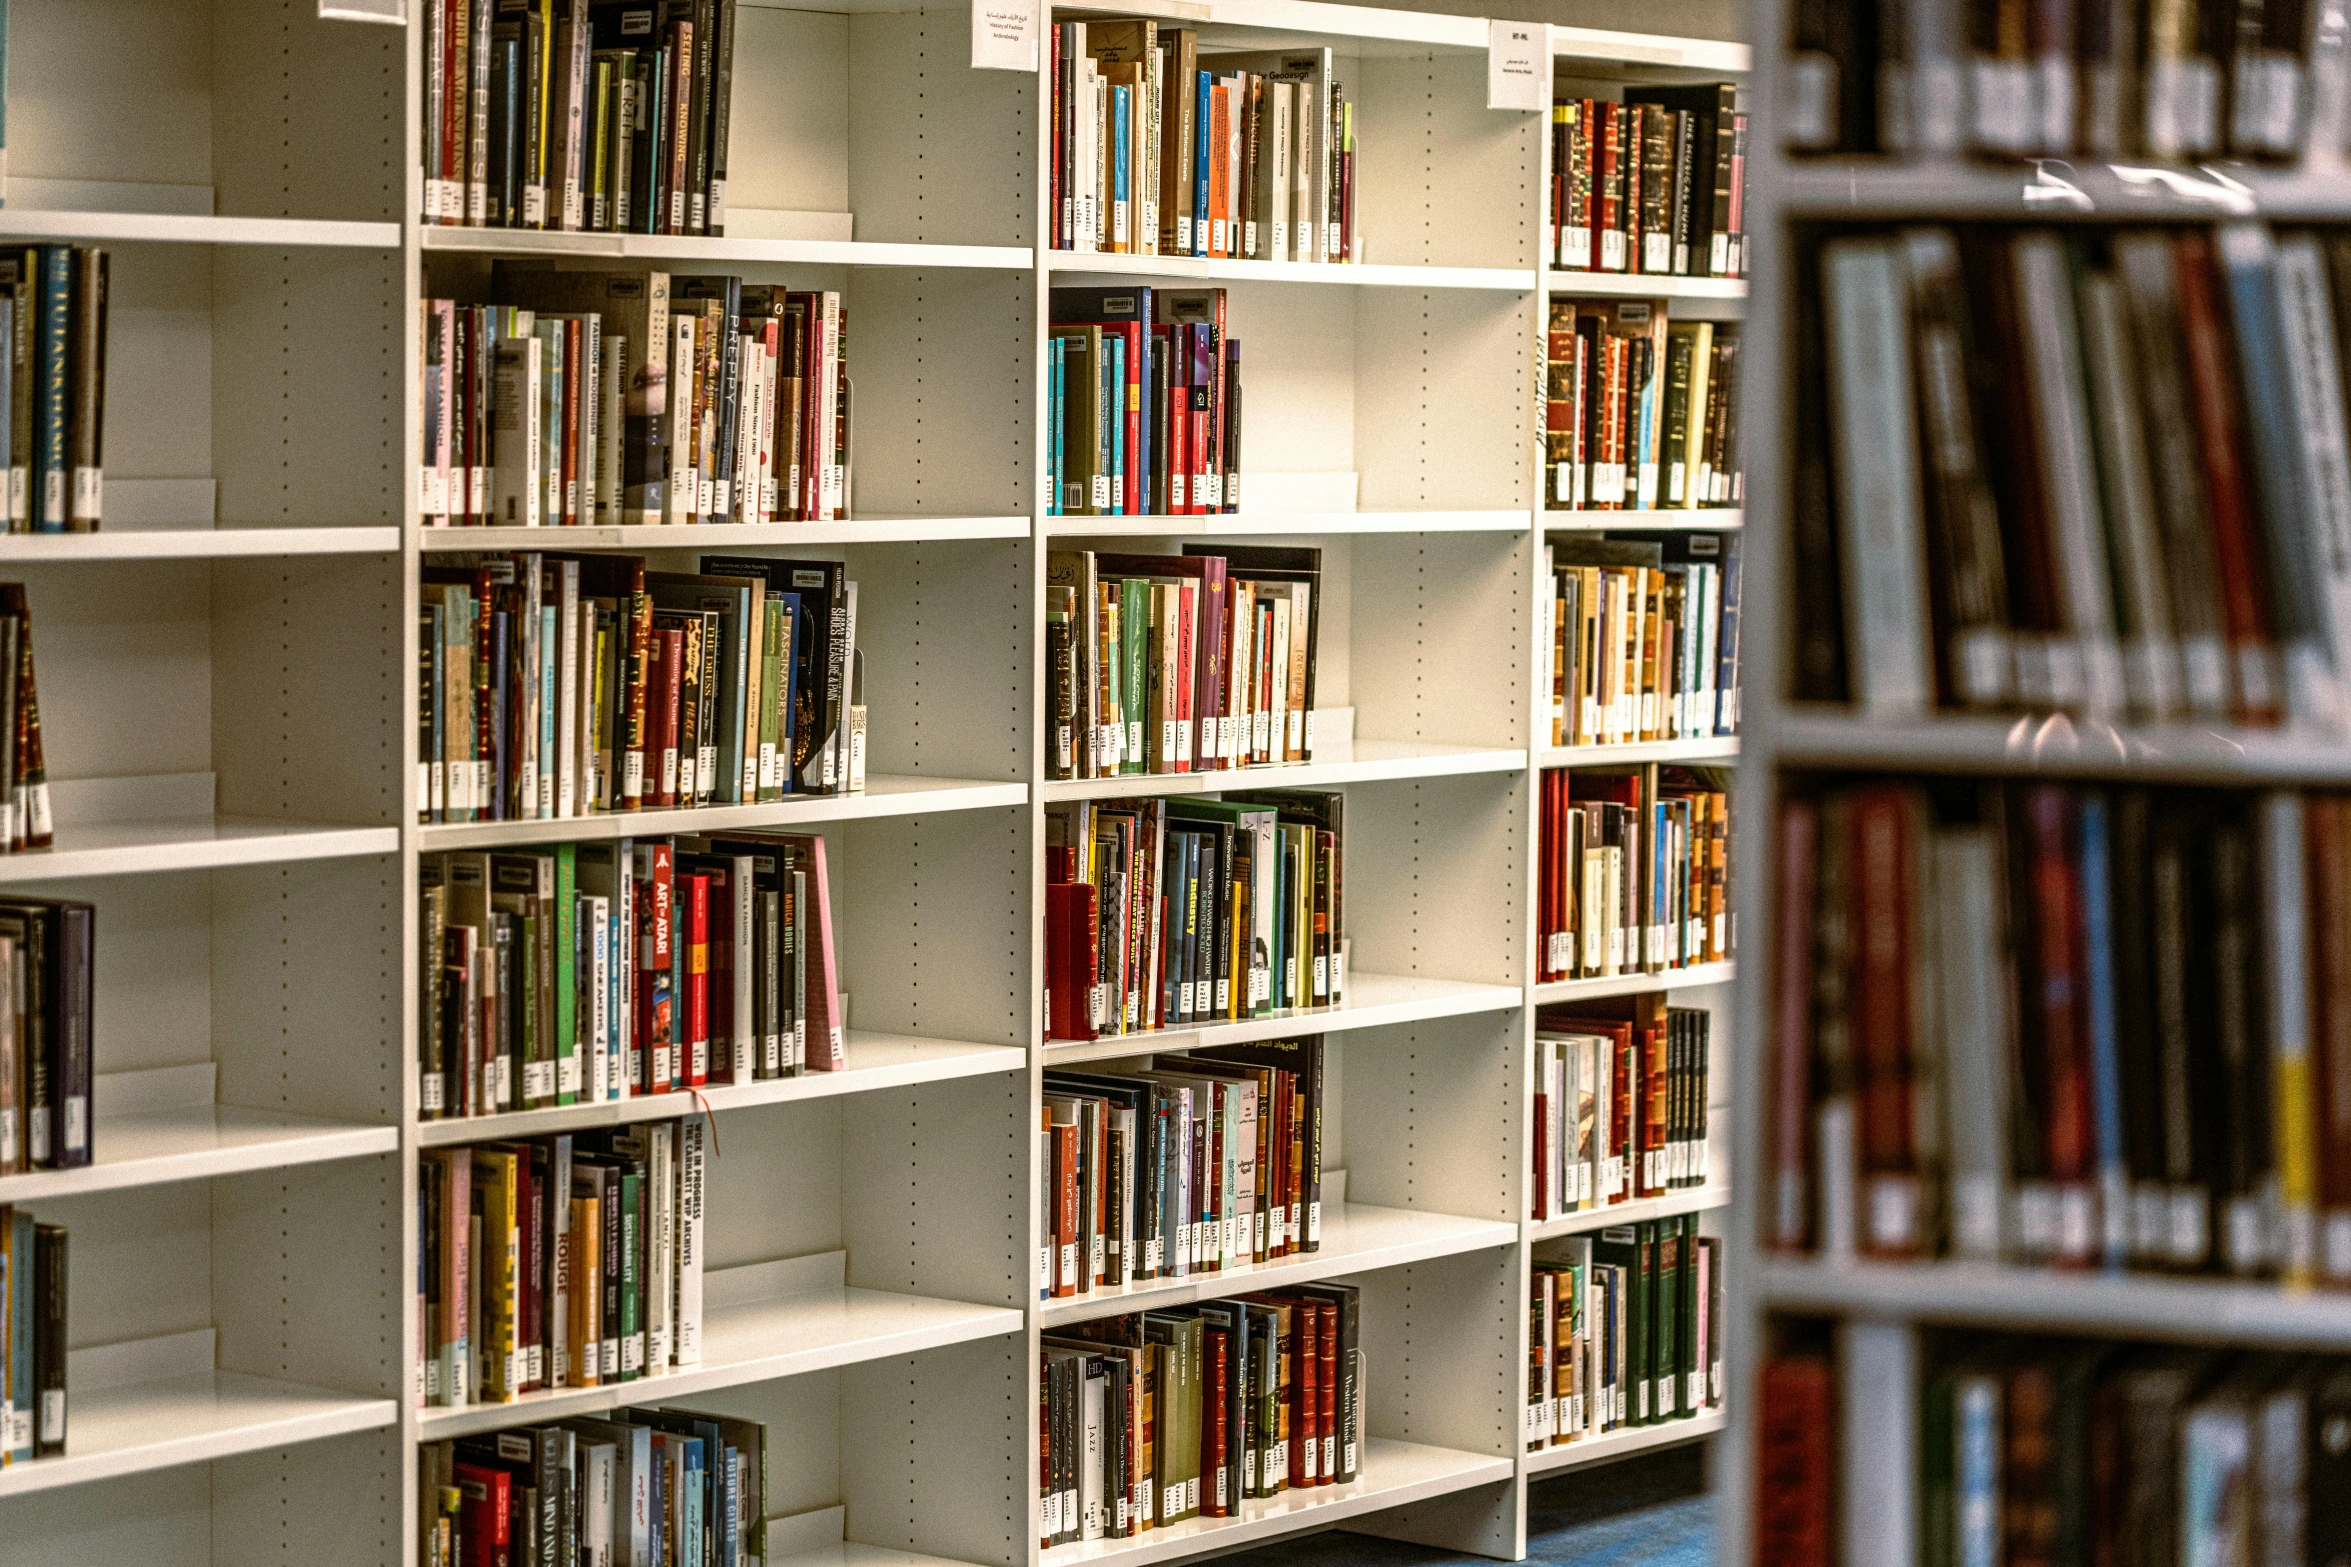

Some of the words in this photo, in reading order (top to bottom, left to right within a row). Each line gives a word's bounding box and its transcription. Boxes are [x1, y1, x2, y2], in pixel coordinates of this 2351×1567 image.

[682, 34, 692, 76] SEEING
[702, 41, 708, 49] OF
[473, 15, 488, 178] STEPPES
[678, 103, 688, 162] KNOWING
[1249, 112, 1260, 164] Medina
[1682, 143, 1692, 201] MUSICAL
[592, 323, 600, 364] FASHION
[726, 315, 740, 406] PREPPY
[572, 336, 580, 398] COMMUNICATING
[590, 376, 598, 434] MODERNISM
[707, 625, 715, 653] THE
[830, 608, 842, 635] SHOES
[671, 643, 680, 684] Dreaming
[704, 656, 714, 696] DRESS
[778, 626, 790, 715] FASCINATORS
[828, 638, 840, 676] PLEASURE
[673, 686, 679, 694] of
[827, 684, 837, 700] PAIN
[685, 702, 696, 740] FIERCE
[624, 898, 629, 906] OF
[657, 883, 667, 908] ART
[1186, 878, 1198, 935] Industry
[1207, 898, 1213, 907] IN
[657, 917, 667, 954] ATARI
[694, 1123, 702, 1151] WORK
[694, 1156, 702, 1166] IN
[693, 1170, 701, 1219] PROGRESS
[624, 1214, 633, 1283] SUSTAINABILITY
[683, 1220, 691, 1266] ARCHIVES
[557, 1232, 568, 1296] ROUGE
[1088, 1362, 1102, 1375] HD
[1344, 1374, 1353, 1413] Western
[727, 1458, 736, 1501] FUTURE
[727, 1506, 736, 1542] CITIES
